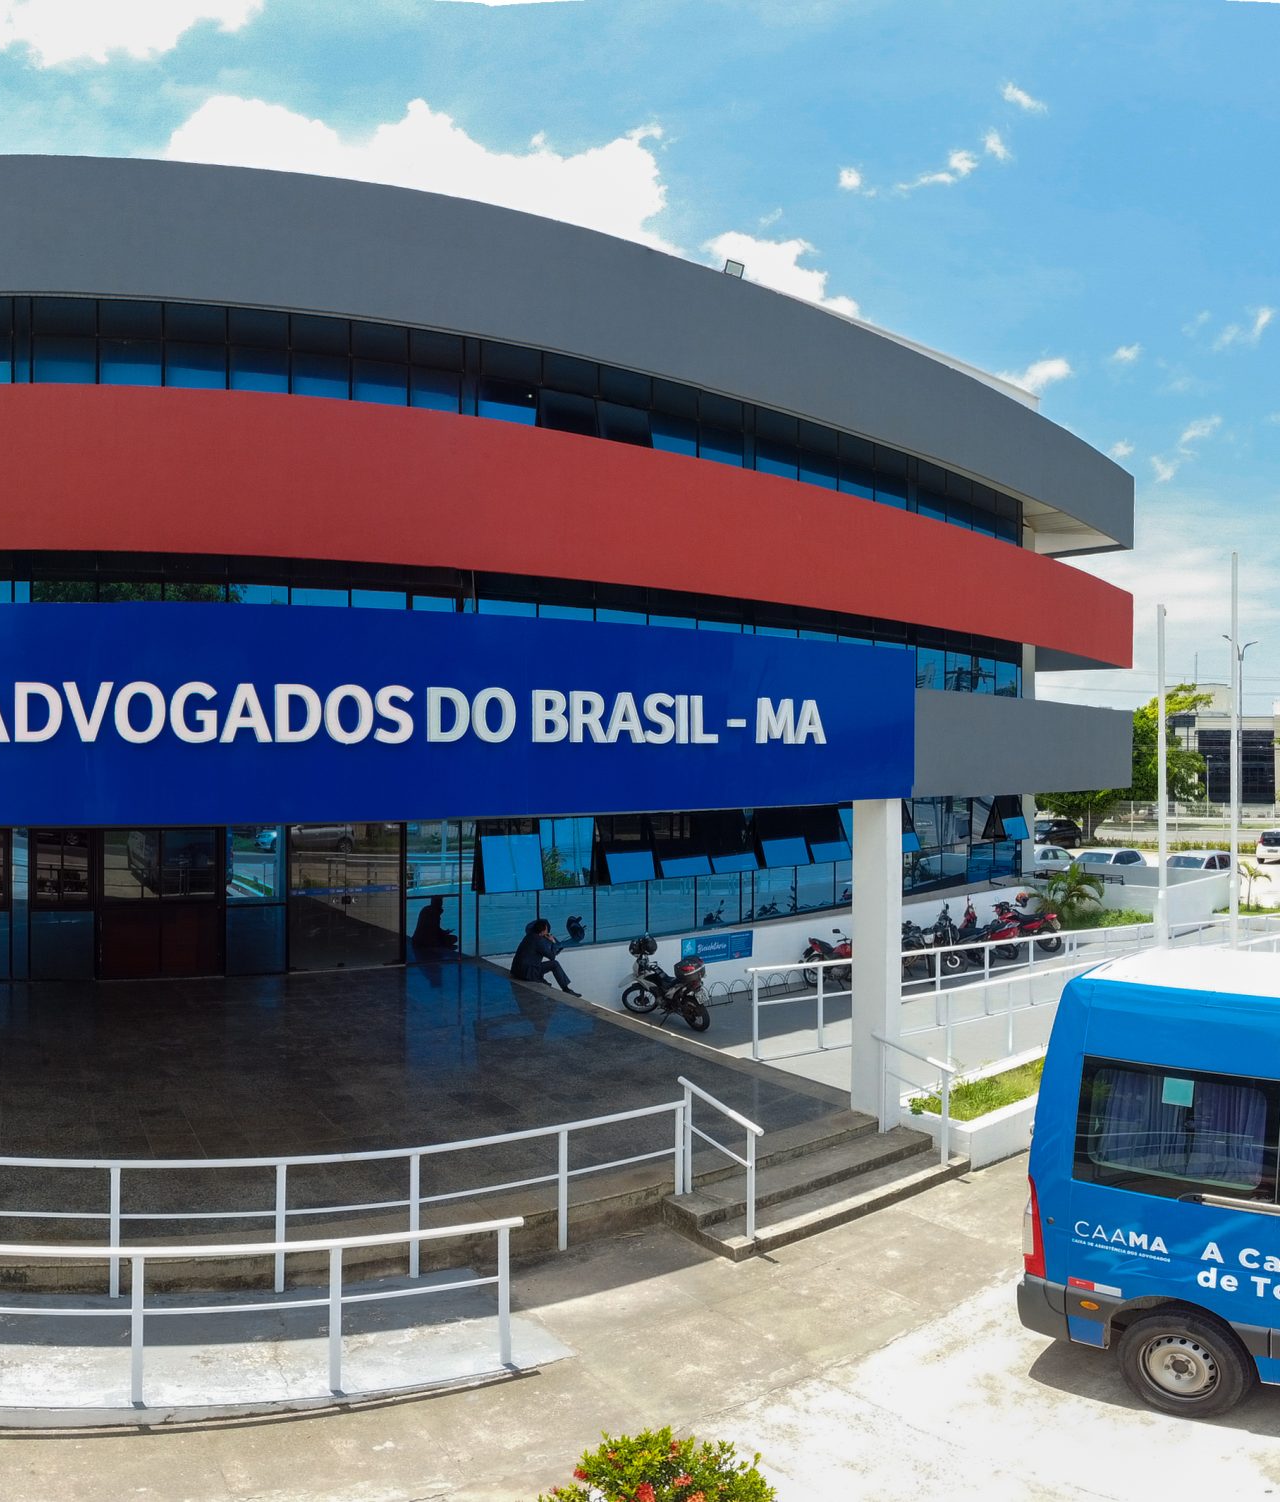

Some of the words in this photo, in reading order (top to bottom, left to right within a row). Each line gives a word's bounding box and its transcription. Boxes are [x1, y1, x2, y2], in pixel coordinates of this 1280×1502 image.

[426, 686, 517, 744] DO
[531, 688, 719, 744] BRASIL
[755, 697, 827, 744] MA
[1074, 1220, 1169, 1254] CAAMA
[1200, 1241, 1225, 1264] A
[1197, 1267, 1239, 1292] de
